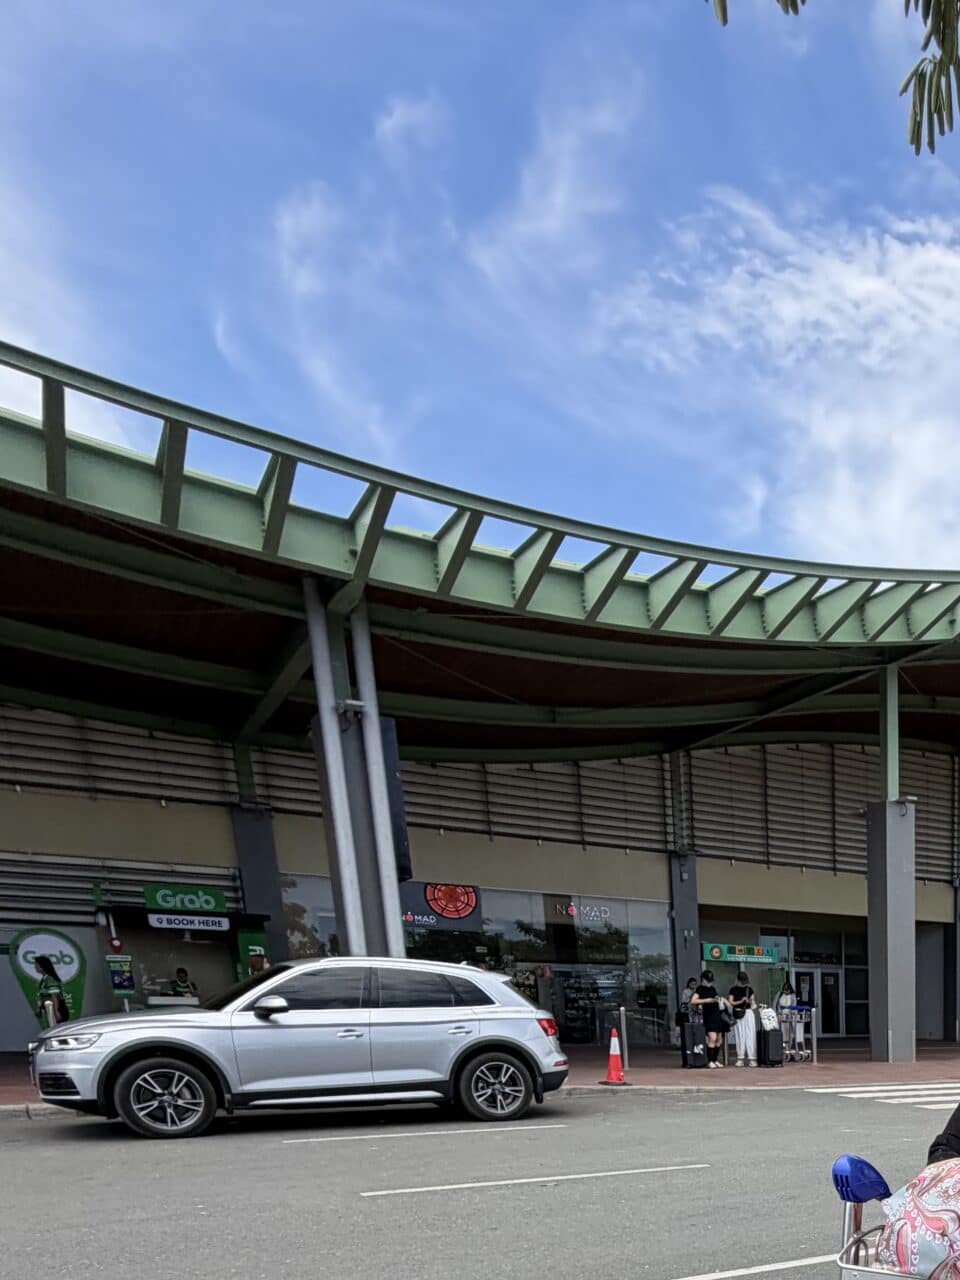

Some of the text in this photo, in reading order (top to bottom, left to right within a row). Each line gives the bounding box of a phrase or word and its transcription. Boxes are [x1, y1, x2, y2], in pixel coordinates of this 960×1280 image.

[156, 889, 216, 910] Grab
[166, 917, 224, 928] BOOK HERE
[22, 949, 74, 966] Gab
